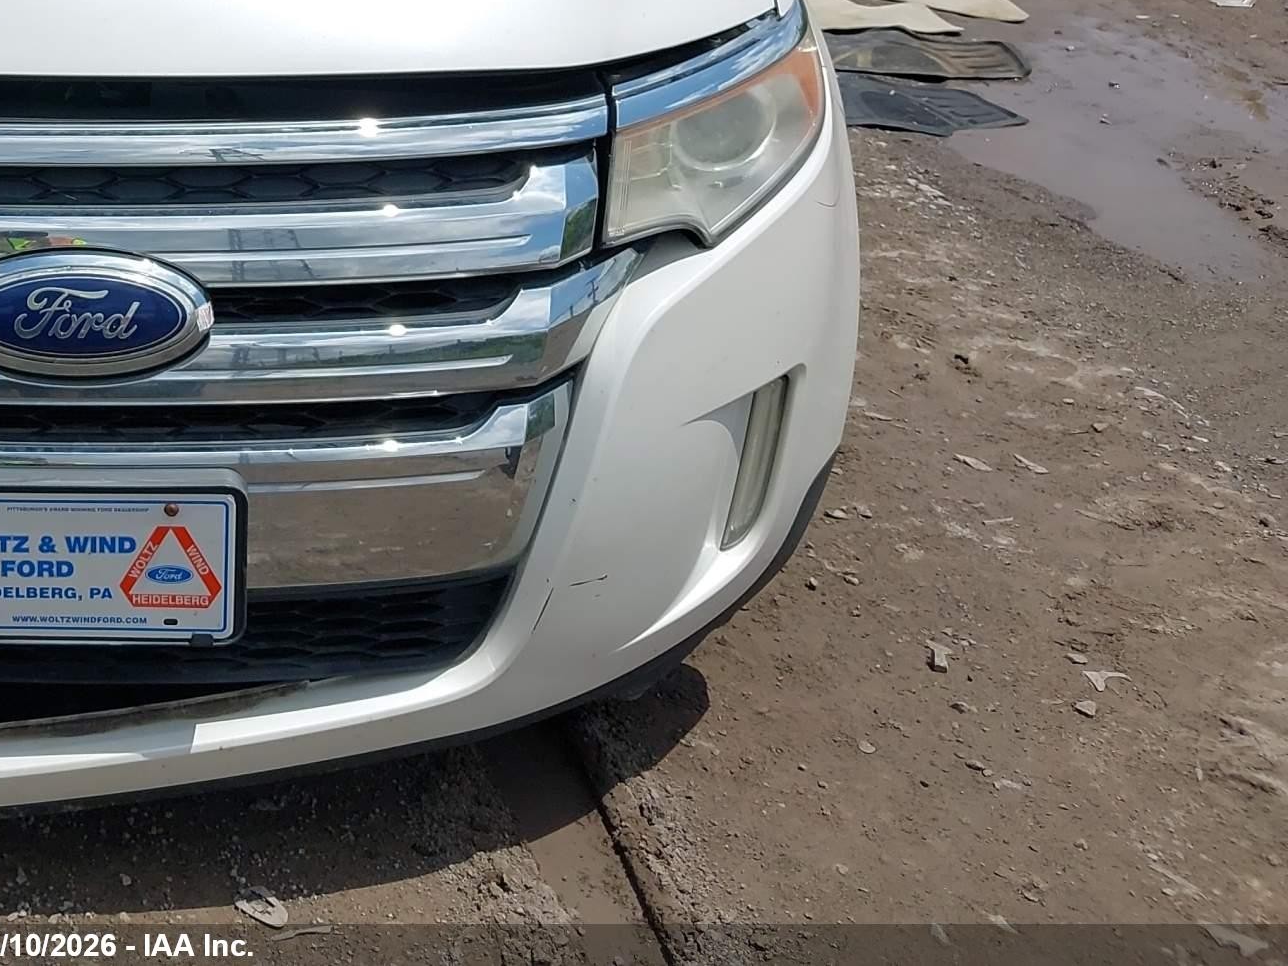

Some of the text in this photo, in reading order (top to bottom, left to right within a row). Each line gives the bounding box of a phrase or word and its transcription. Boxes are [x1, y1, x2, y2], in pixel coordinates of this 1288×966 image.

[14, 286, 141, 339] Ford
[38, 536, 57, 553] &
[65, 536, 136, 554] WIND
[128, 541, 159, 578] WOLTZ
[186, 544, 210, 575] WIND
[0, 560, 74, 578] FORD
[155, 569, 183, 580] Ford
[89, 587, 113, 599] PA
[132, 594, 209, 606] HEIDELBERG
[12, 615, 147, 624] WWW.WOLTZWINDFORD.COM
